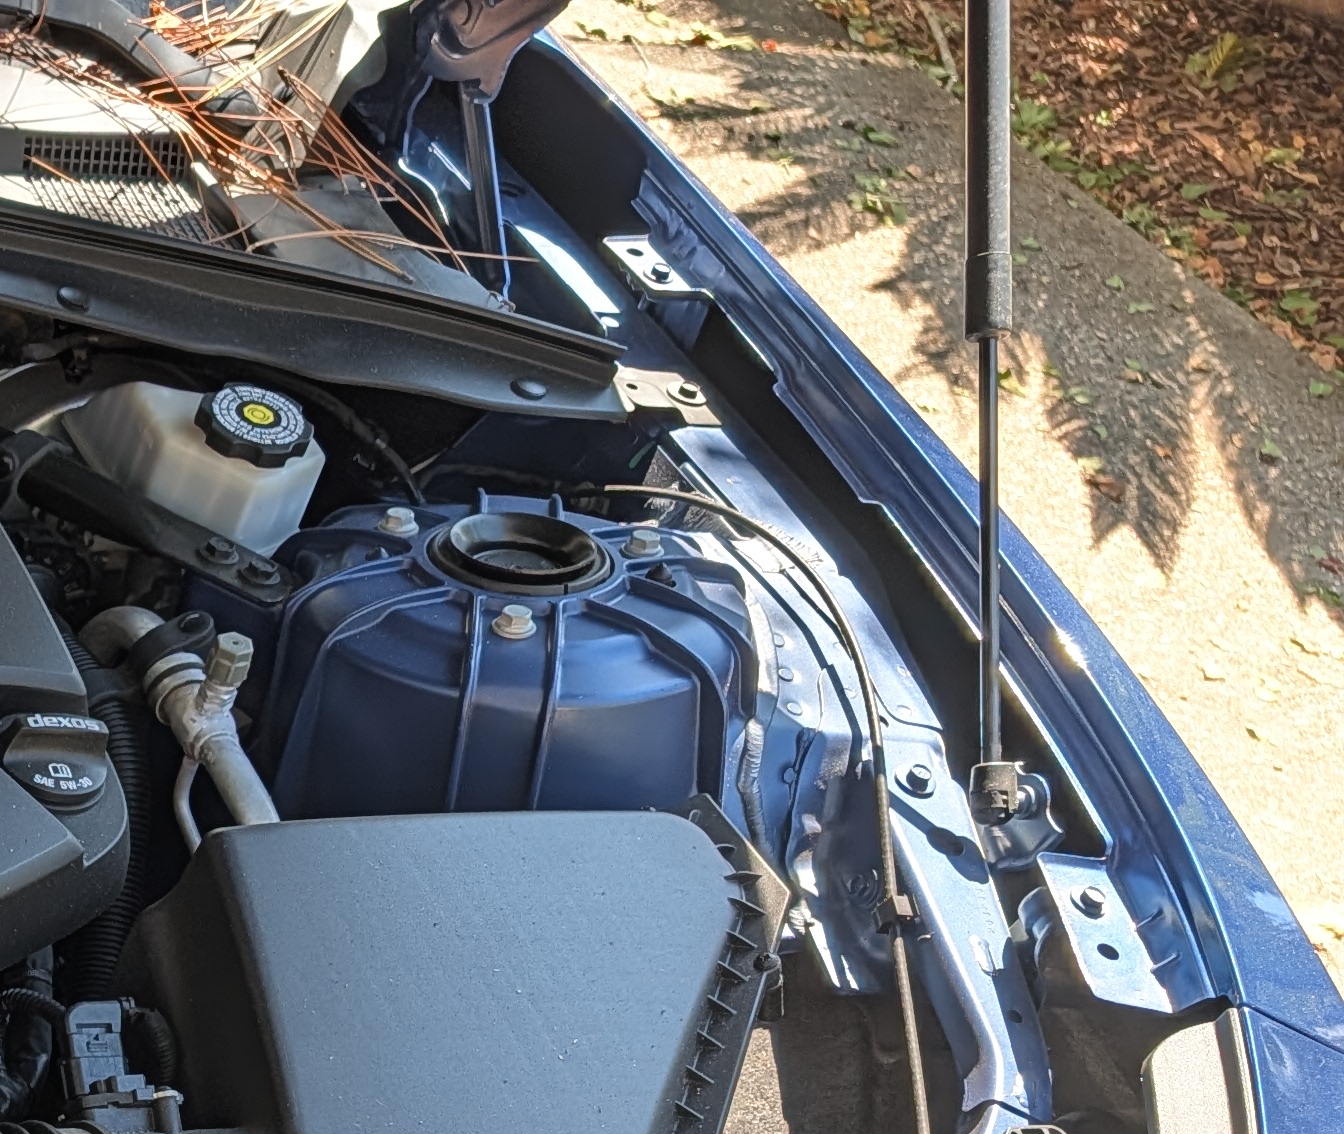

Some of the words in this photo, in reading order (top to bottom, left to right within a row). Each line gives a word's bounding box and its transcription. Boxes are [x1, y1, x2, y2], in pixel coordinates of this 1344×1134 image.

[27, 713, 100, 731] dexos
[33, 773, 55, 788] SAE
[59, 776, 93, 790] 5W-30
